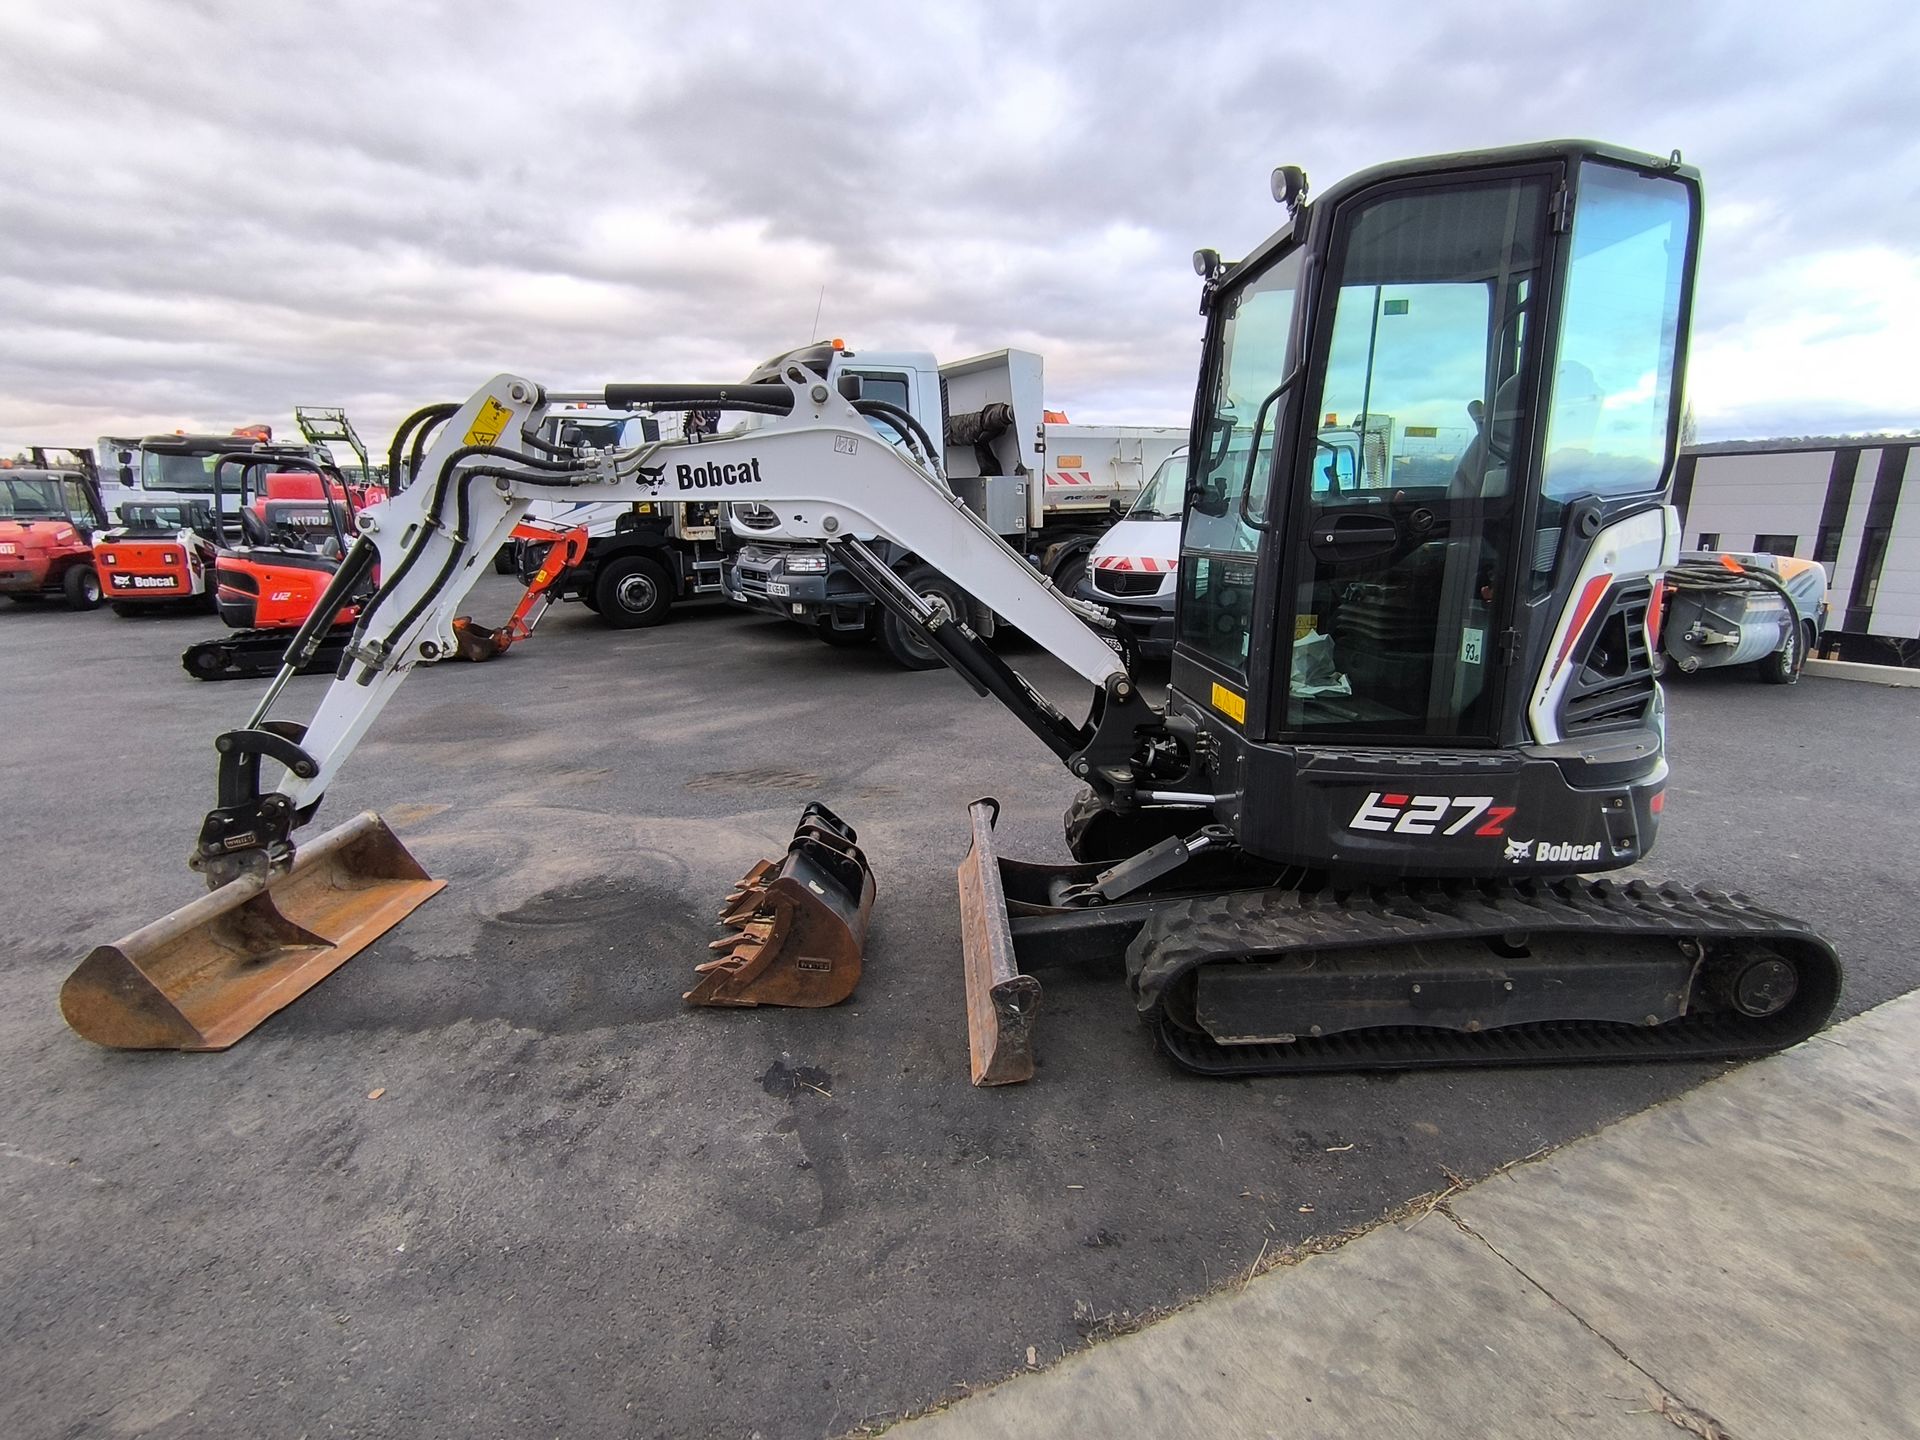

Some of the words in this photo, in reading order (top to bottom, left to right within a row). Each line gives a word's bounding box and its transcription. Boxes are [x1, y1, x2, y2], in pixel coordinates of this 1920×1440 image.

[676, 458, 761, 490] Bobcat
[134, 577, 175, 587] Bobcat
[1536, 841, 1601, 862] Bobcat
